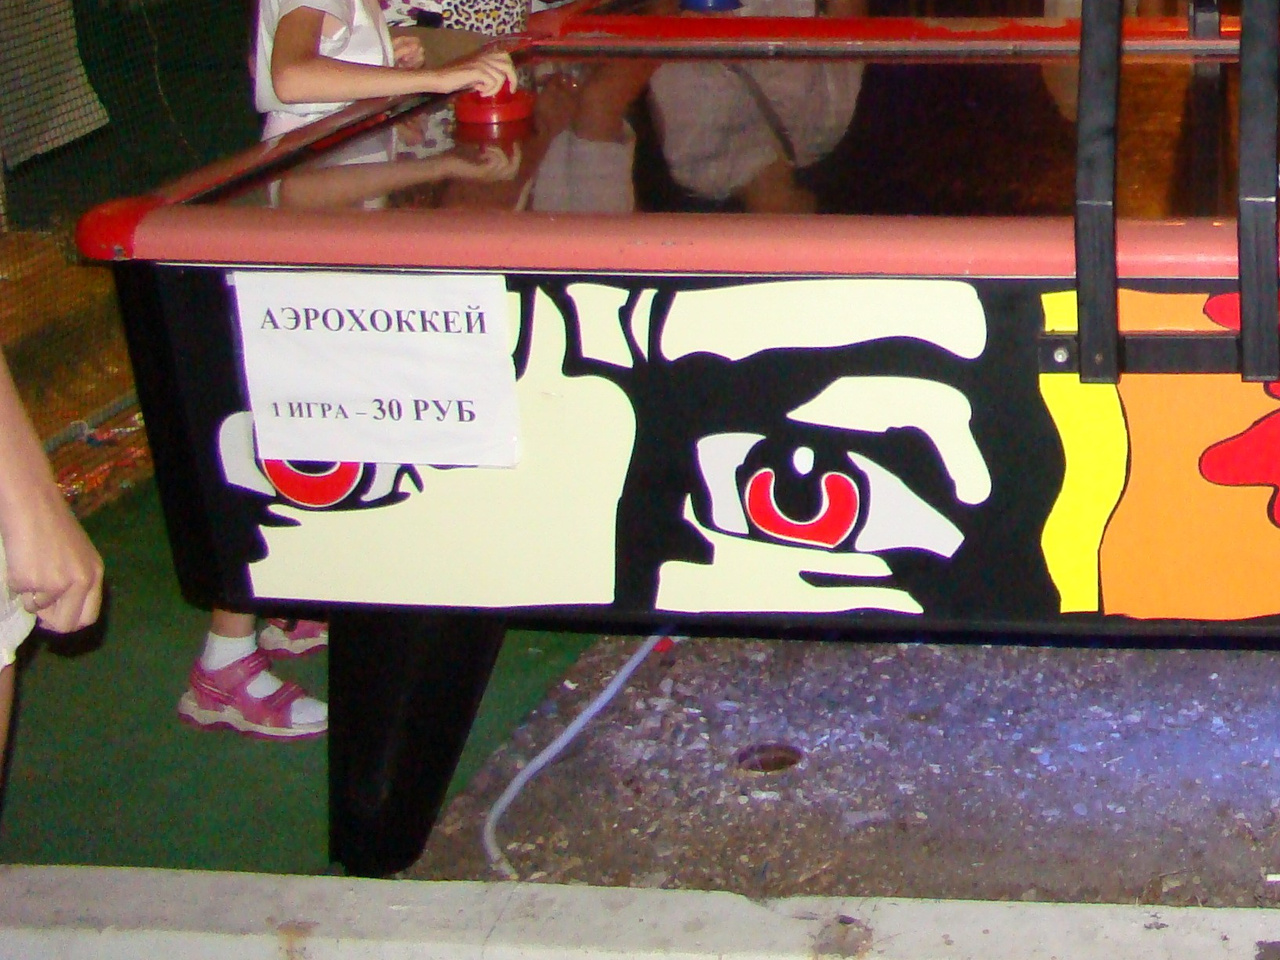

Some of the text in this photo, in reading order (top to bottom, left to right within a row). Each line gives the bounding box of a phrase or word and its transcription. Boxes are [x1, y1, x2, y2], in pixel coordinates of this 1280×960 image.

[260, 304, 488, 334] АЭРОХОККЕЙ
[272, 402, 281, 418] 1
[288, 401, 349, 420] ИГРА
[372, 398, 402, 422] 30
[413, 399, 477, 423] РУБ
